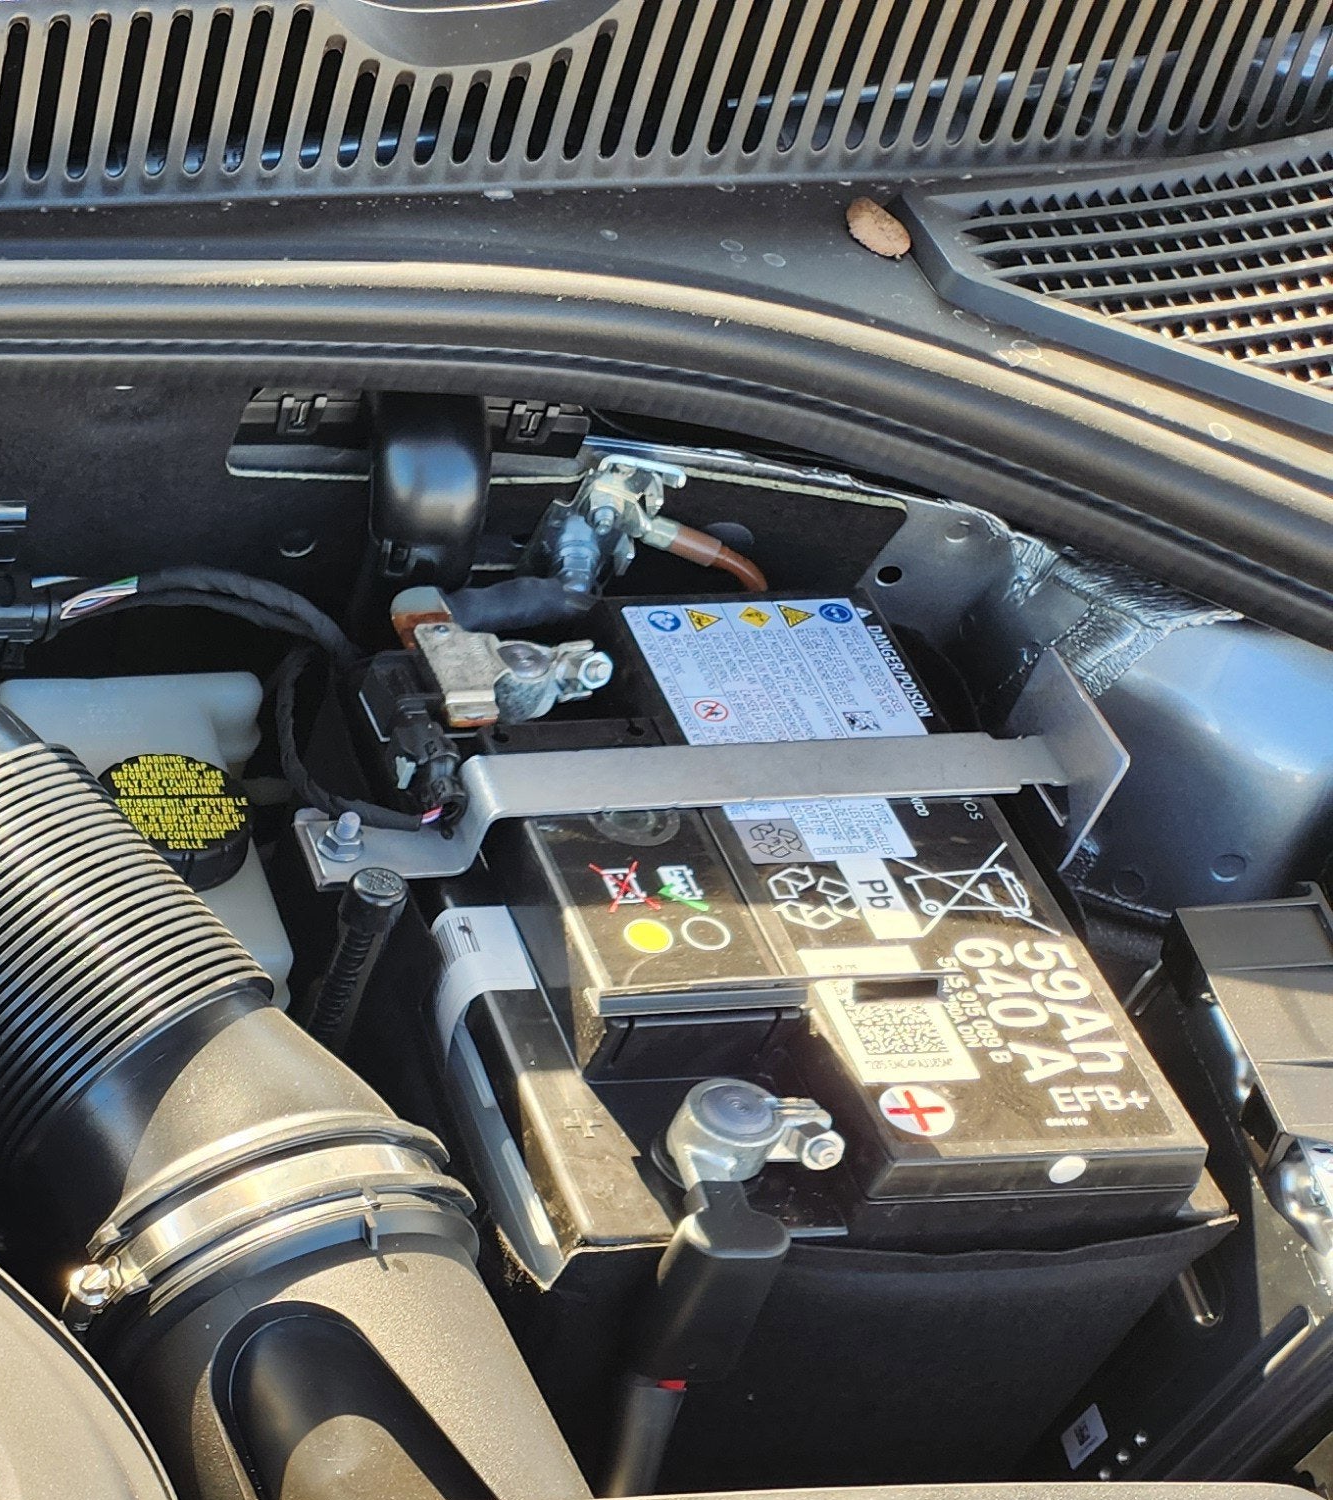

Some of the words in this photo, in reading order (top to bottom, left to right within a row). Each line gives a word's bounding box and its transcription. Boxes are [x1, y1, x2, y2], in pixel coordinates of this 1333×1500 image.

[864, 624, 935, 717] DANGER/POISON
[138, 755, 186, 764] WARNING:
[122, 763, 153, 772] CLEAN
[154, 763, 187, 772] FILLER
[189, 763, 207, 771] CAP
[111, 772, 149, 780] BEFORE
[205, 770, 223, 779] USE
[114, 780, 140, 788] ONLY
[141, 780, 160, 788] DOT
[169, 779, 197, 788] FLUID
[198, 779, 225, 787] FROM
[120, 788, 128, 796] A
[128, 787, 165, 796] SEALED
[166, 787, 225, 795] CONTAINER.
[114, 798, 184, 807] ERTISSEMENT:
[185, 798, 234, 806] NETTOYER
[236, 797, 248, 806] LE
[910, 797, 930, 817] XICO
[122, 807, 162, 815] OUCHON
[164, 806, 195, 815] AVANT
[199, 806, 210, 814] DE
[149, 815, 209, 823] N'EMPLOYER
[211, 814, 232, 823] QUE
[233, 814, 246, 822] DU
[185, 822, 240, 831] PROVENANT
[167, 831, 226, 840] CONTENANT
[857, 879, 895, 910] Pb
[954, 938, 1049, 1028] 640
[1008, 1040, 1077, 1083] A
[1014, 940, 1129, 1074] 59Ah
[956, 987, 986, 1019] 915
[974, 1018, 1003, 1048] 089
[989, 1050, 1013, 1064] B
[957, 1025, 981, 1048] DIN
[1049, 1085, 1149, 1112] EFB+
